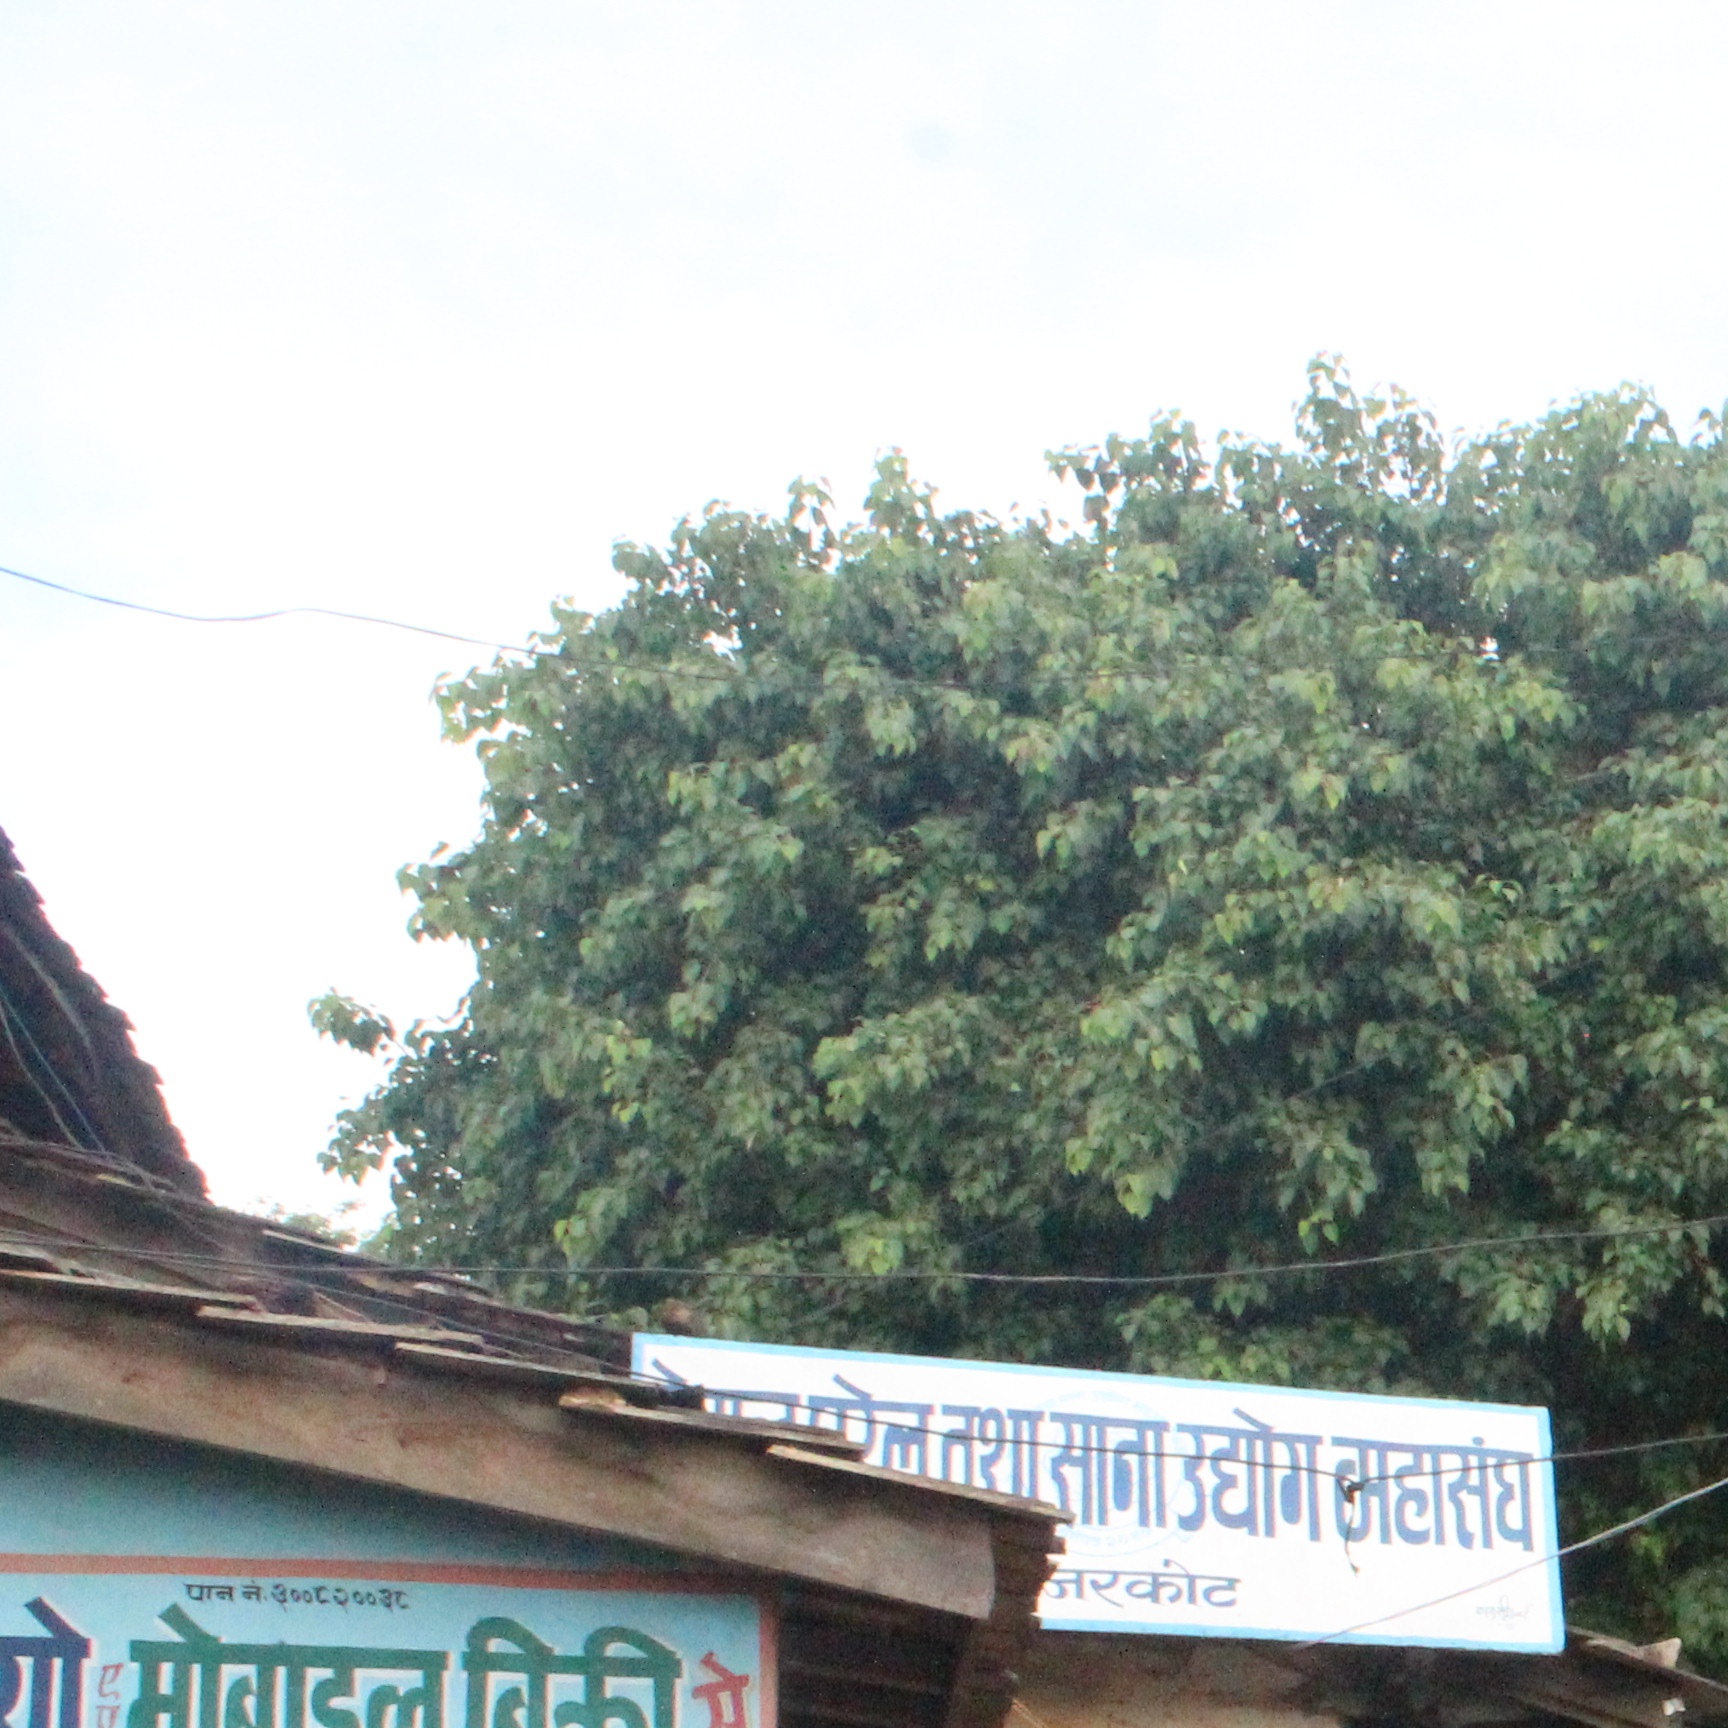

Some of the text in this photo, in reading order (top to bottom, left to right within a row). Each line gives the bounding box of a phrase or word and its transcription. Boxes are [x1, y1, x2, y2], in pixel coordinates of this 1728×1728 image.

[1050, 1410, 1169, 1528] साना
[1176, 1406, 1324, 1543] उद्योग
[1331, 1436, 1535, 1552] महासंघ
[184, 1582, 235, 1603] पान
